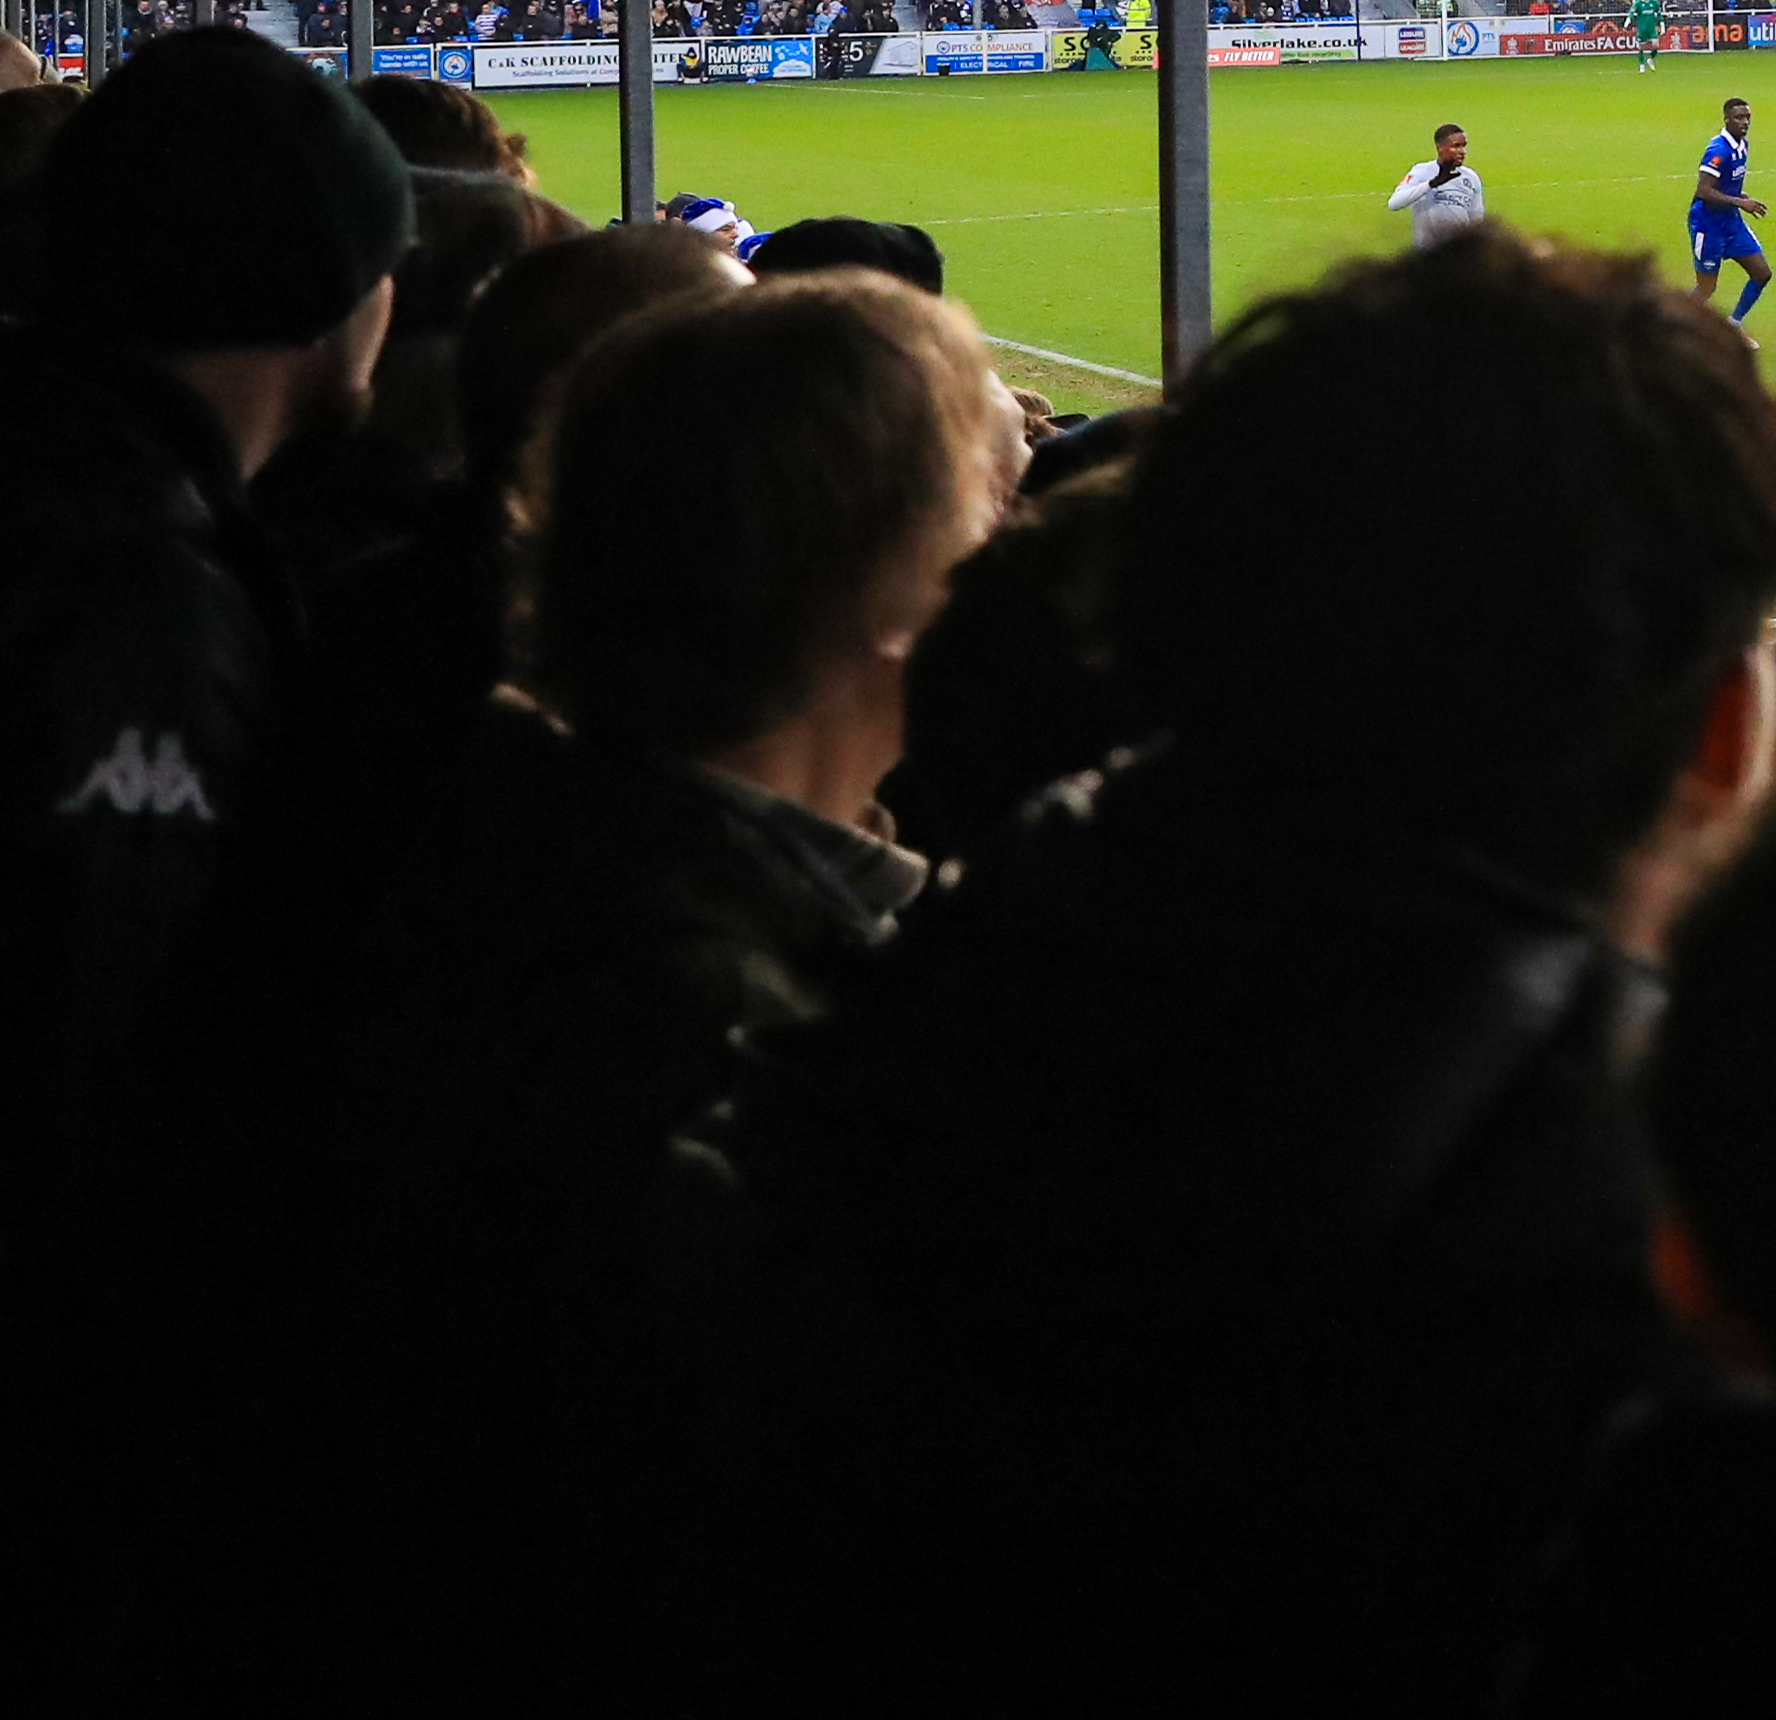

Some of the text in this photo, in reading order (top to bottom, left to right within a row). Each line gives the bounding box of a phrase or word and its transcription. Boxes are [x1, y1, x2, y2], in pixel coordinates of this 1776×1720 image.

[849, 41, 864, 61] 5
[951, 44, 968, 52] PTS
[1544, 36, 1595, 52] Emirates
[1597, 37, 1614, 51] FA
[708, 45, 773, 65] RAWBEAN
[1224, 52, 1240, 63] FLY
[1241, 51, 1275, 62] BETTER
[708, 64, 738, 75] PROPER
